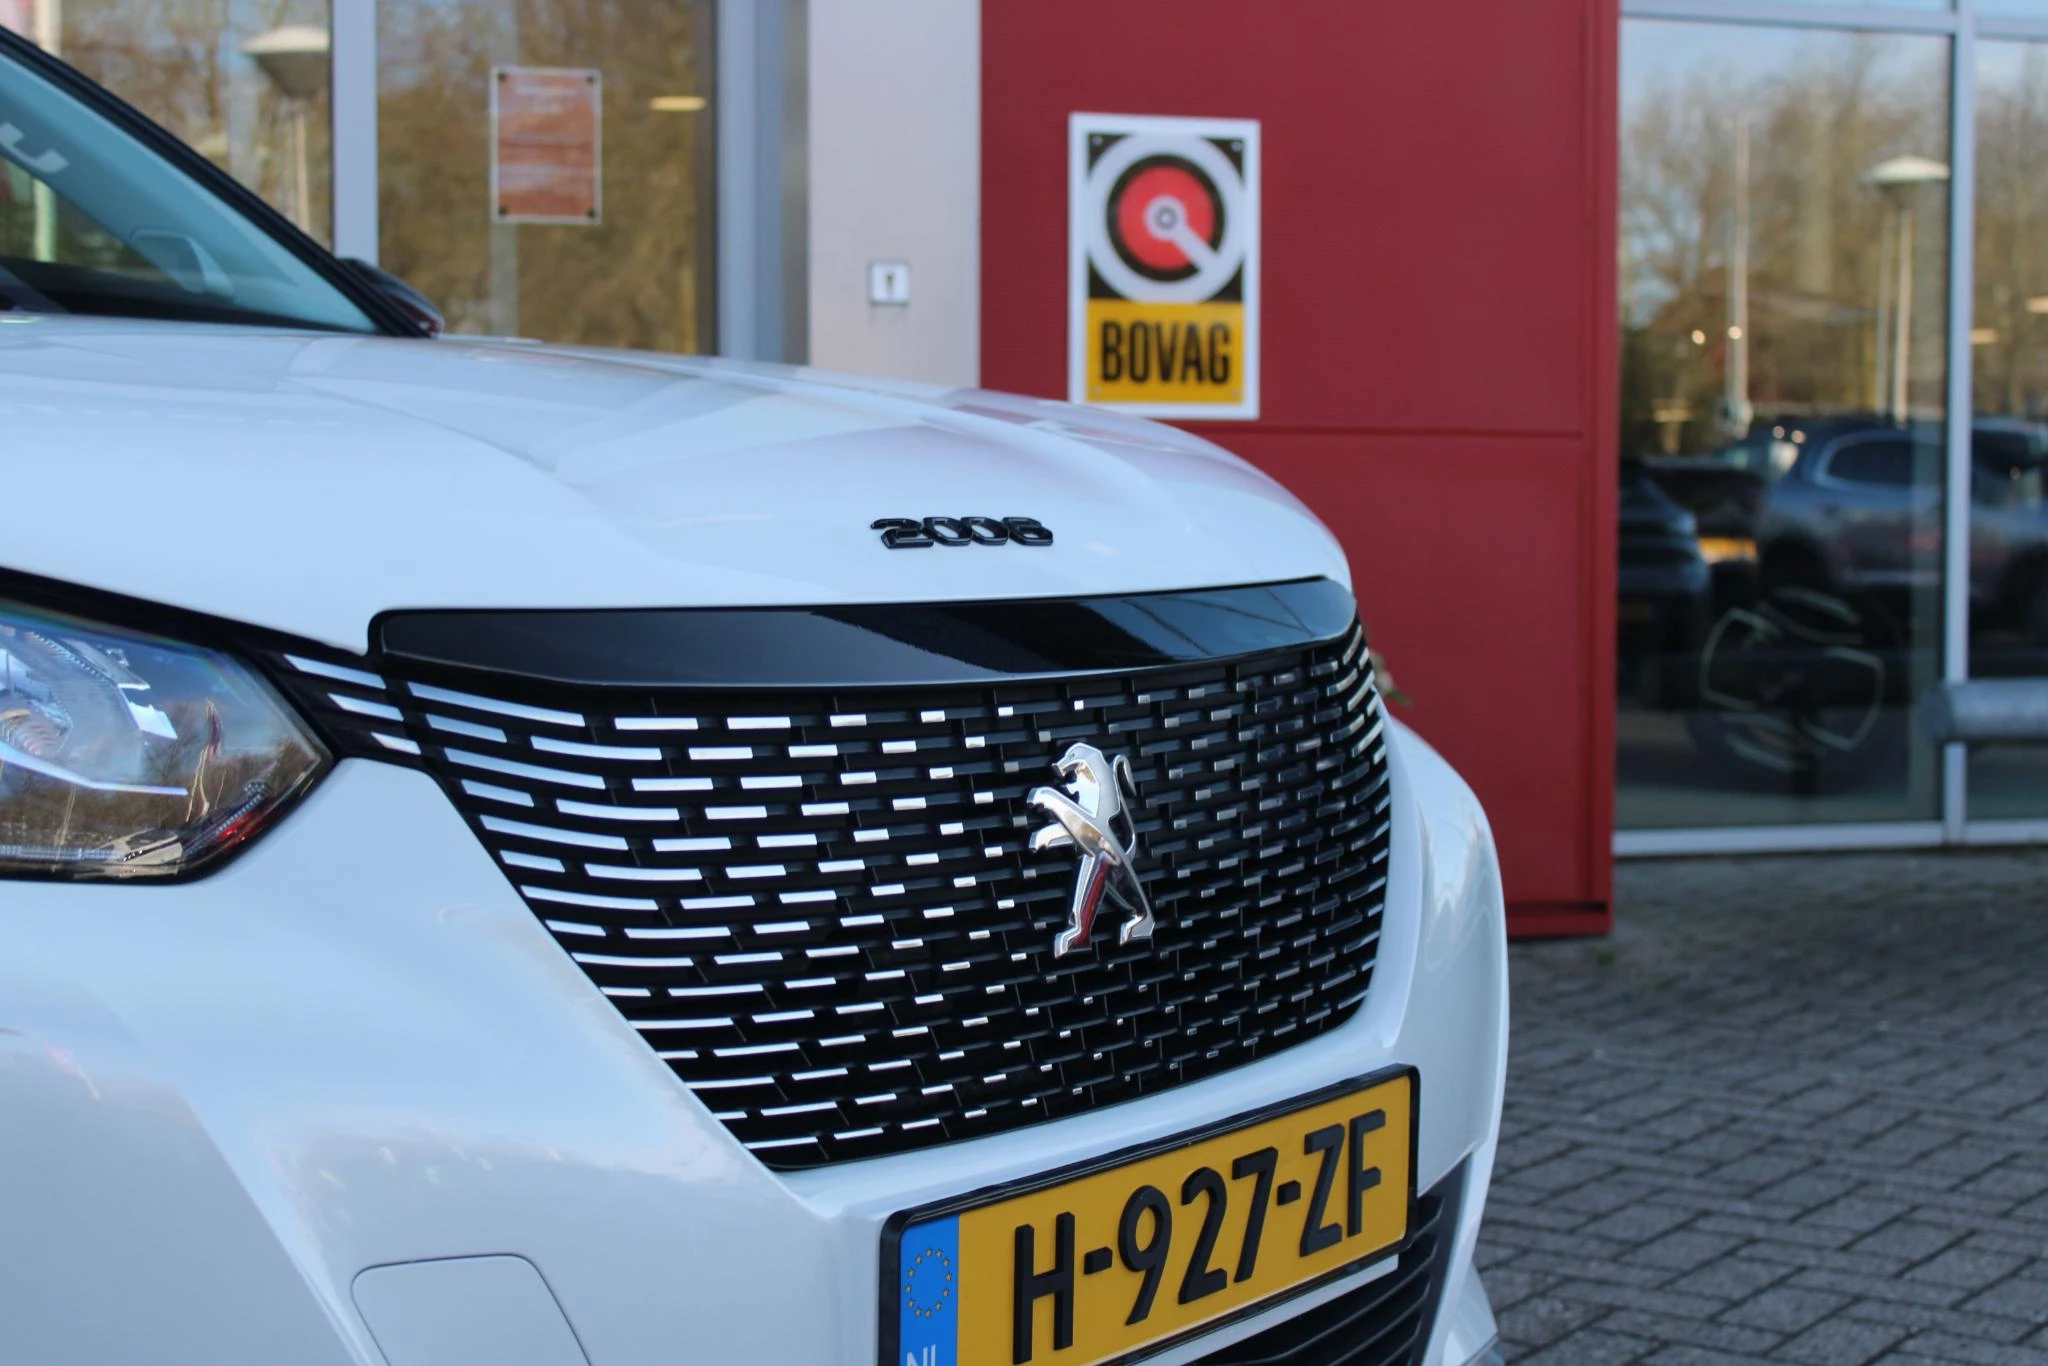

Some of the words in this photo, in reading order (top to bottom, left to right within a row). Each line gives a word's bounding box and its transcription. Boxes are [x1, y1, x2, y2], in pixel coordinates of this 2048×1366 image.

[1101, 321, 1230, 384] BOVAG
[870, 516, 1053, 549] 2008
[1012, 1108, 1386, 1364] H-927-ZF
